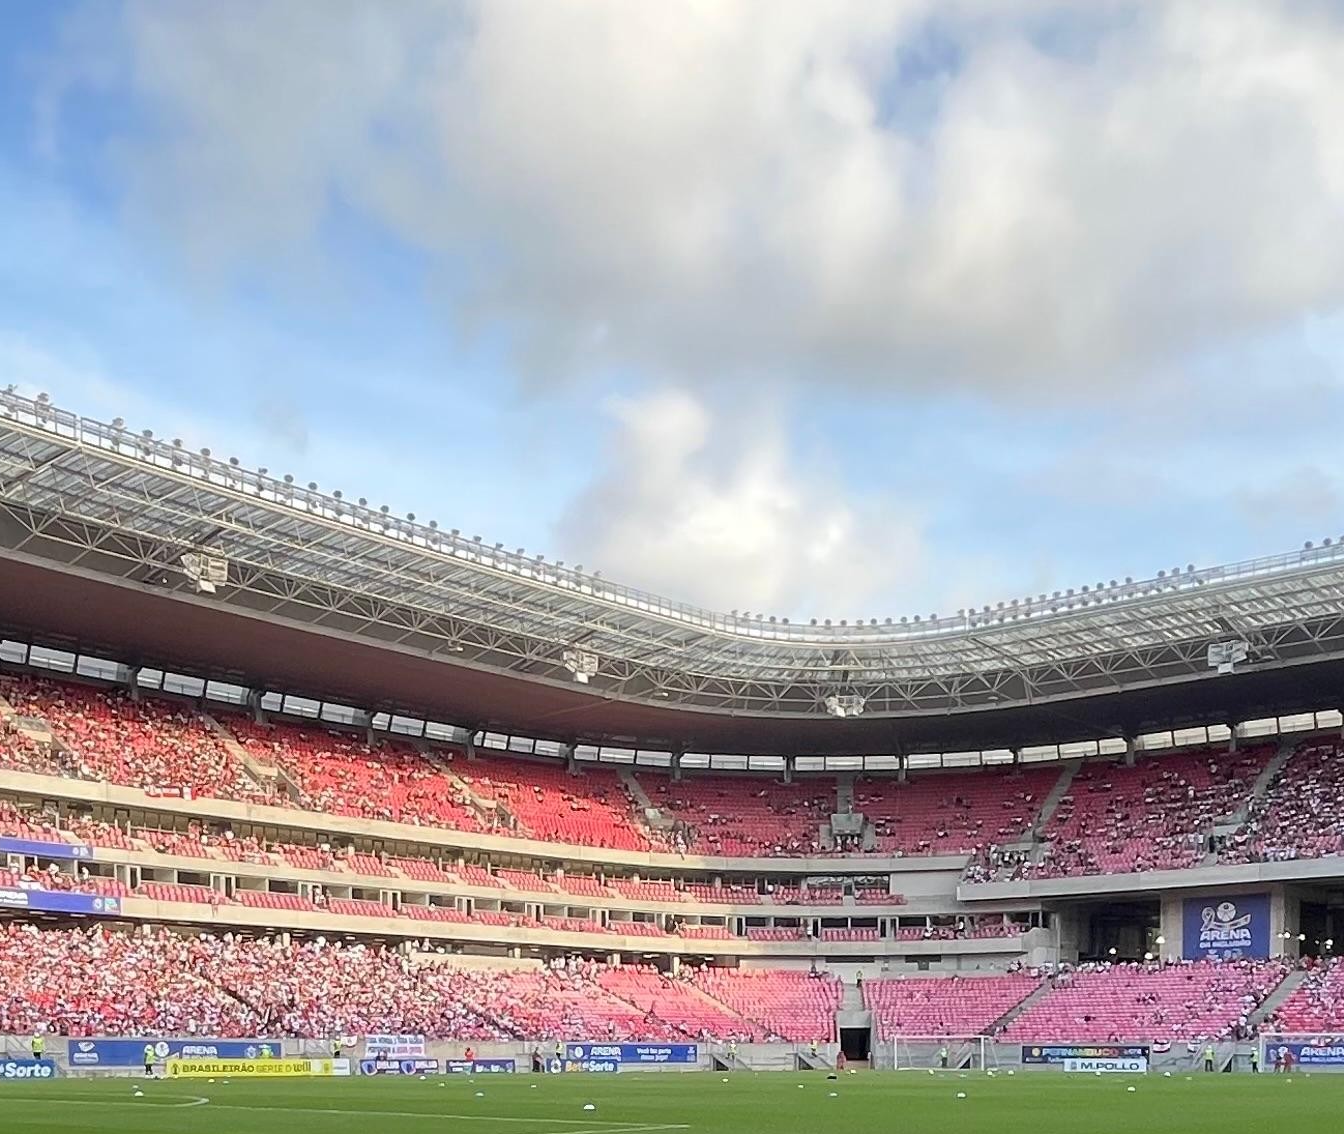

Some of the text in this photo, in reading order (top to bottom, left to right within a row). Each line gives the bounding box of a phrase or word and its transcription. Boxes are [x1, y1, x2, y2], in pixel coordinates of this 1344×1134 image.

[1200, 928, 1252, 941] ARENA
[182, 1045, 219, 1055] ARENA
[1042, 1048, 1120, 1057] PERNAMBUCO
[4, 1063, 52, 1078] Sorte
[182, 1063, 255, 1074] BRASILEIRÃO
[1080, 1062, 1140, 1071] M.POLLO
